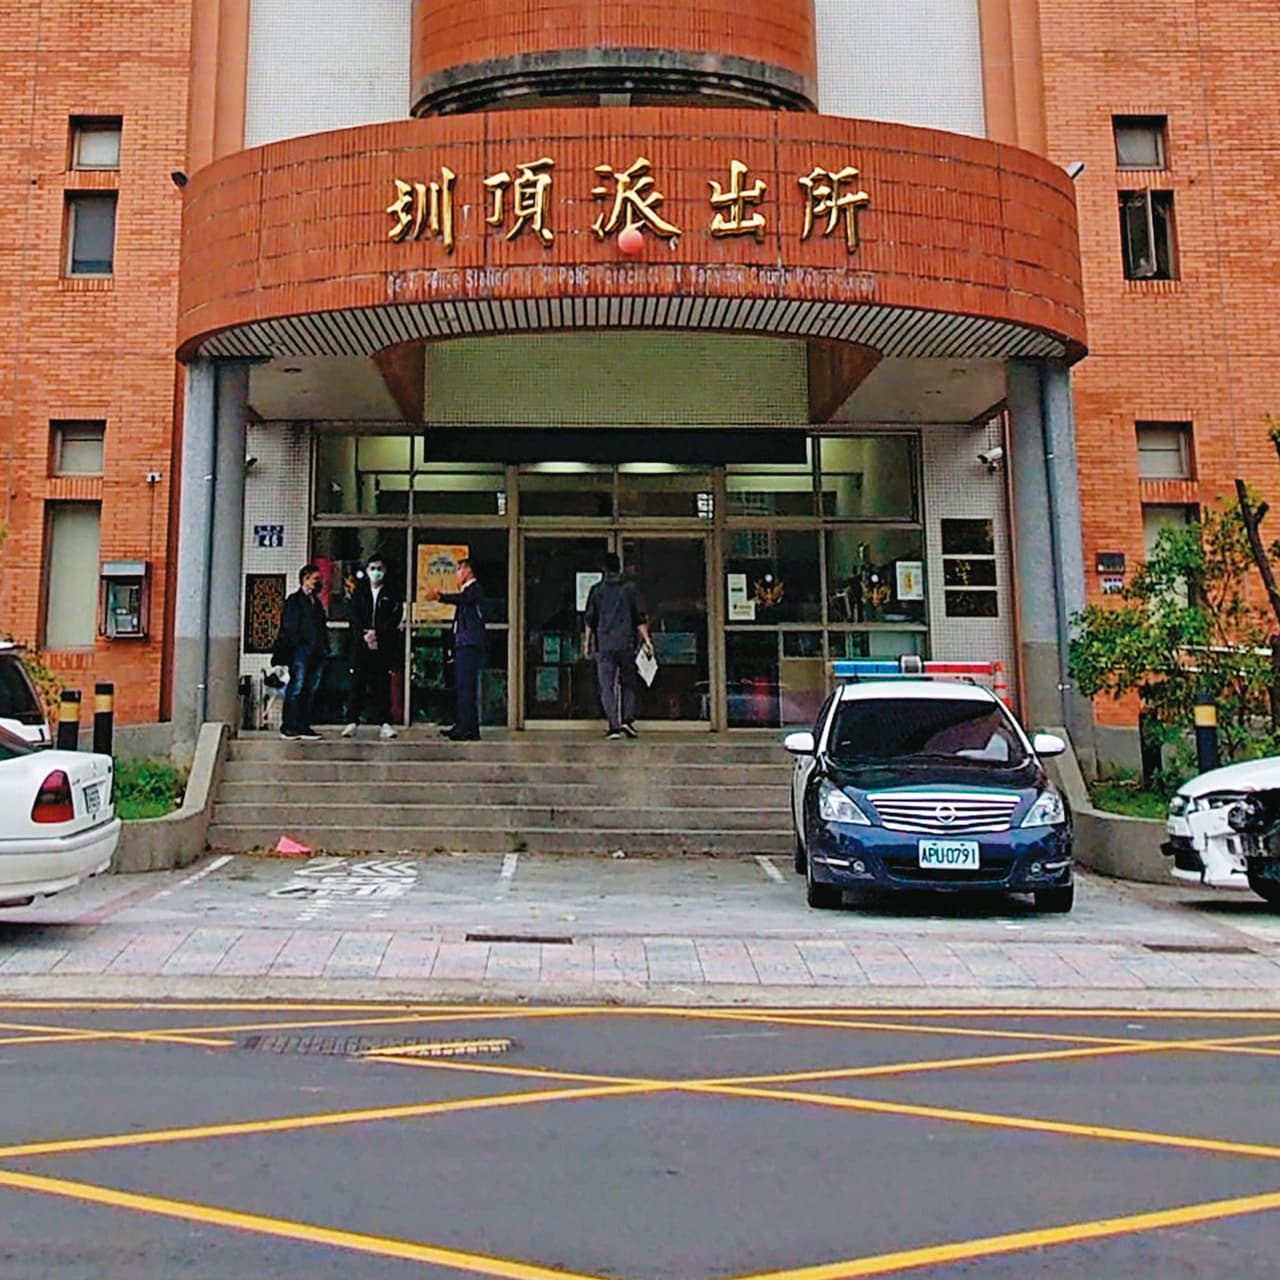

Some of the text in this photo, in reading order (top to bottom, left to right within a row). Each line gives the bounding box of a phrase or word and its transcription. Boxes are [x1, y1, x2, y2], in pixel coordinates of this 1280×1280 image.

[386, 157, 871, 254] 圳頂派出所
[921, 847, 976, 864] APU-0791
